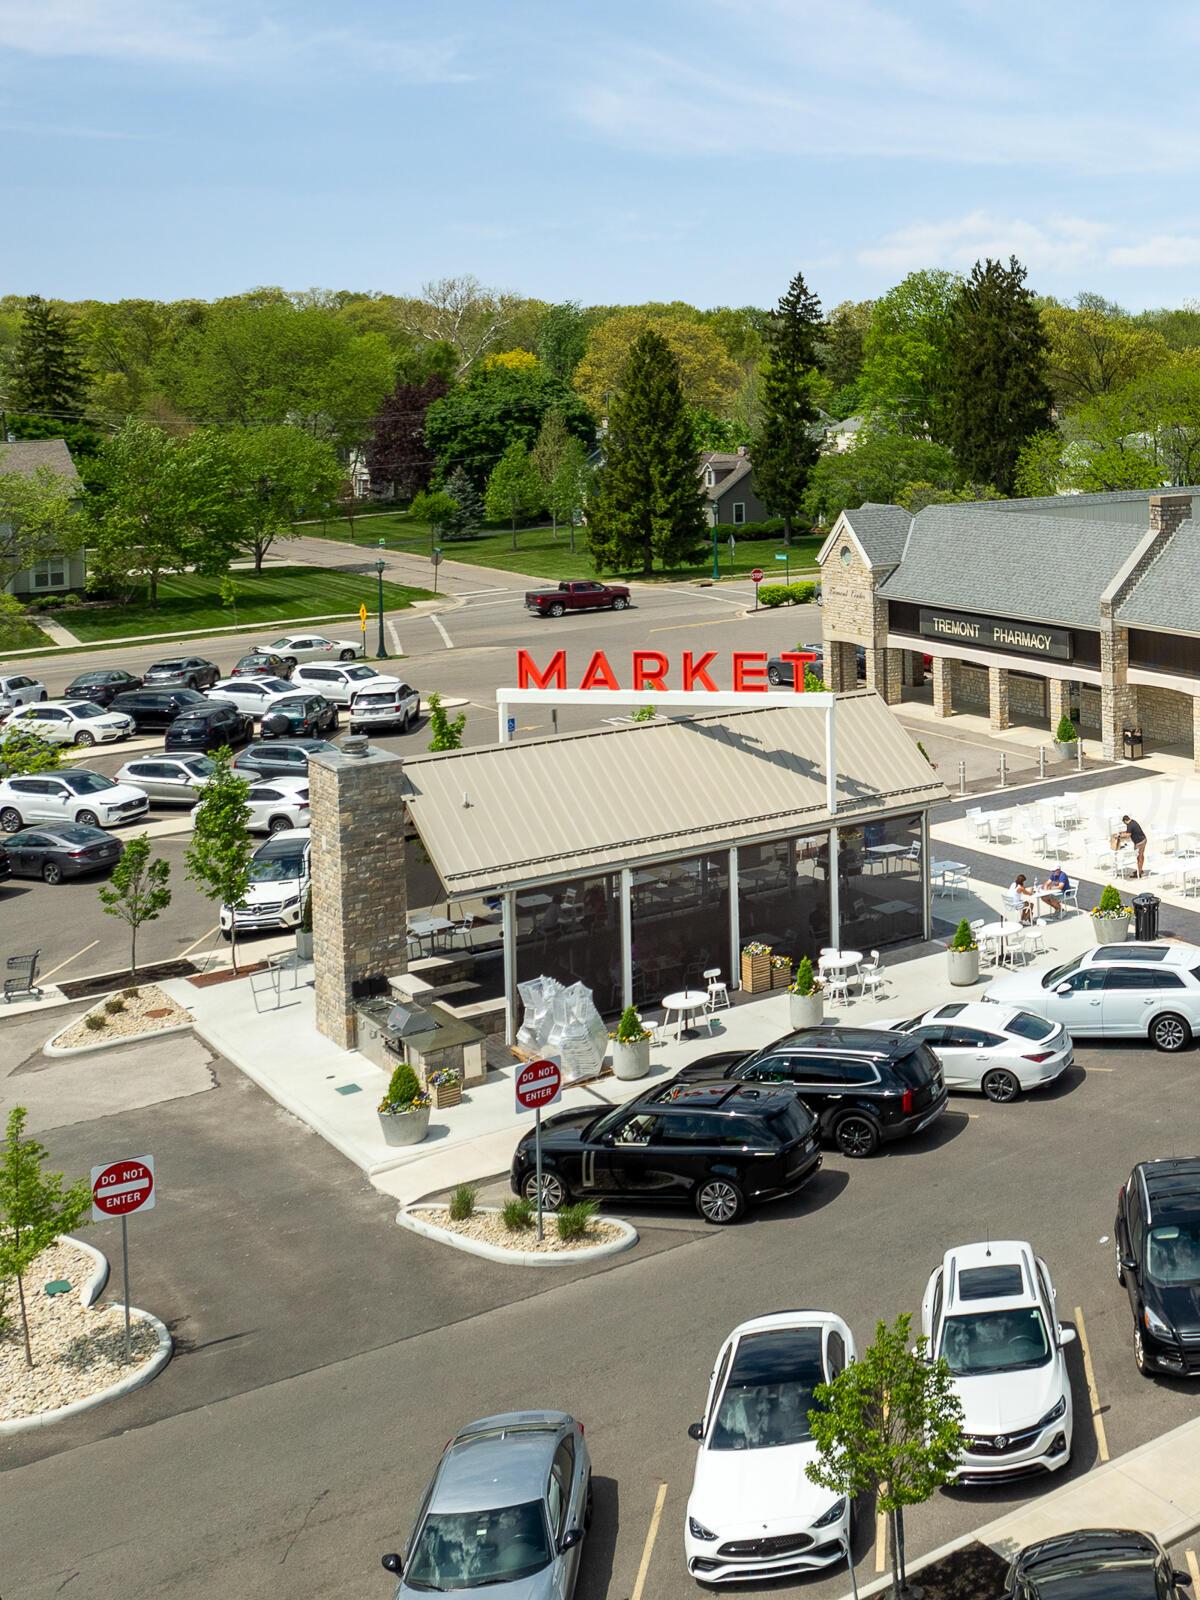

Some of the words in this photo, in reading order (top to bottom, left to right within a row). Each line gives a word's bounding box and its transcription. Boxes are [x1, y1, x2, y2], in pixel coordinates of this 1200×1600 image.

[932, 617, 980, 638] TREMONT
[993, 627, 1052, 651] PHARMACY
[516, 649, 817, 692] MARKET
[522, 1072, 534, 1082] DO
[538, 1066, 554, 1078] NOT
[525, 1088, 552, 1102] ENTER
[101, 1174, 116, 1185] DO
[122, 1167, 144, 1180] NOT
[106, 1192, 141, 1208] ENTER
